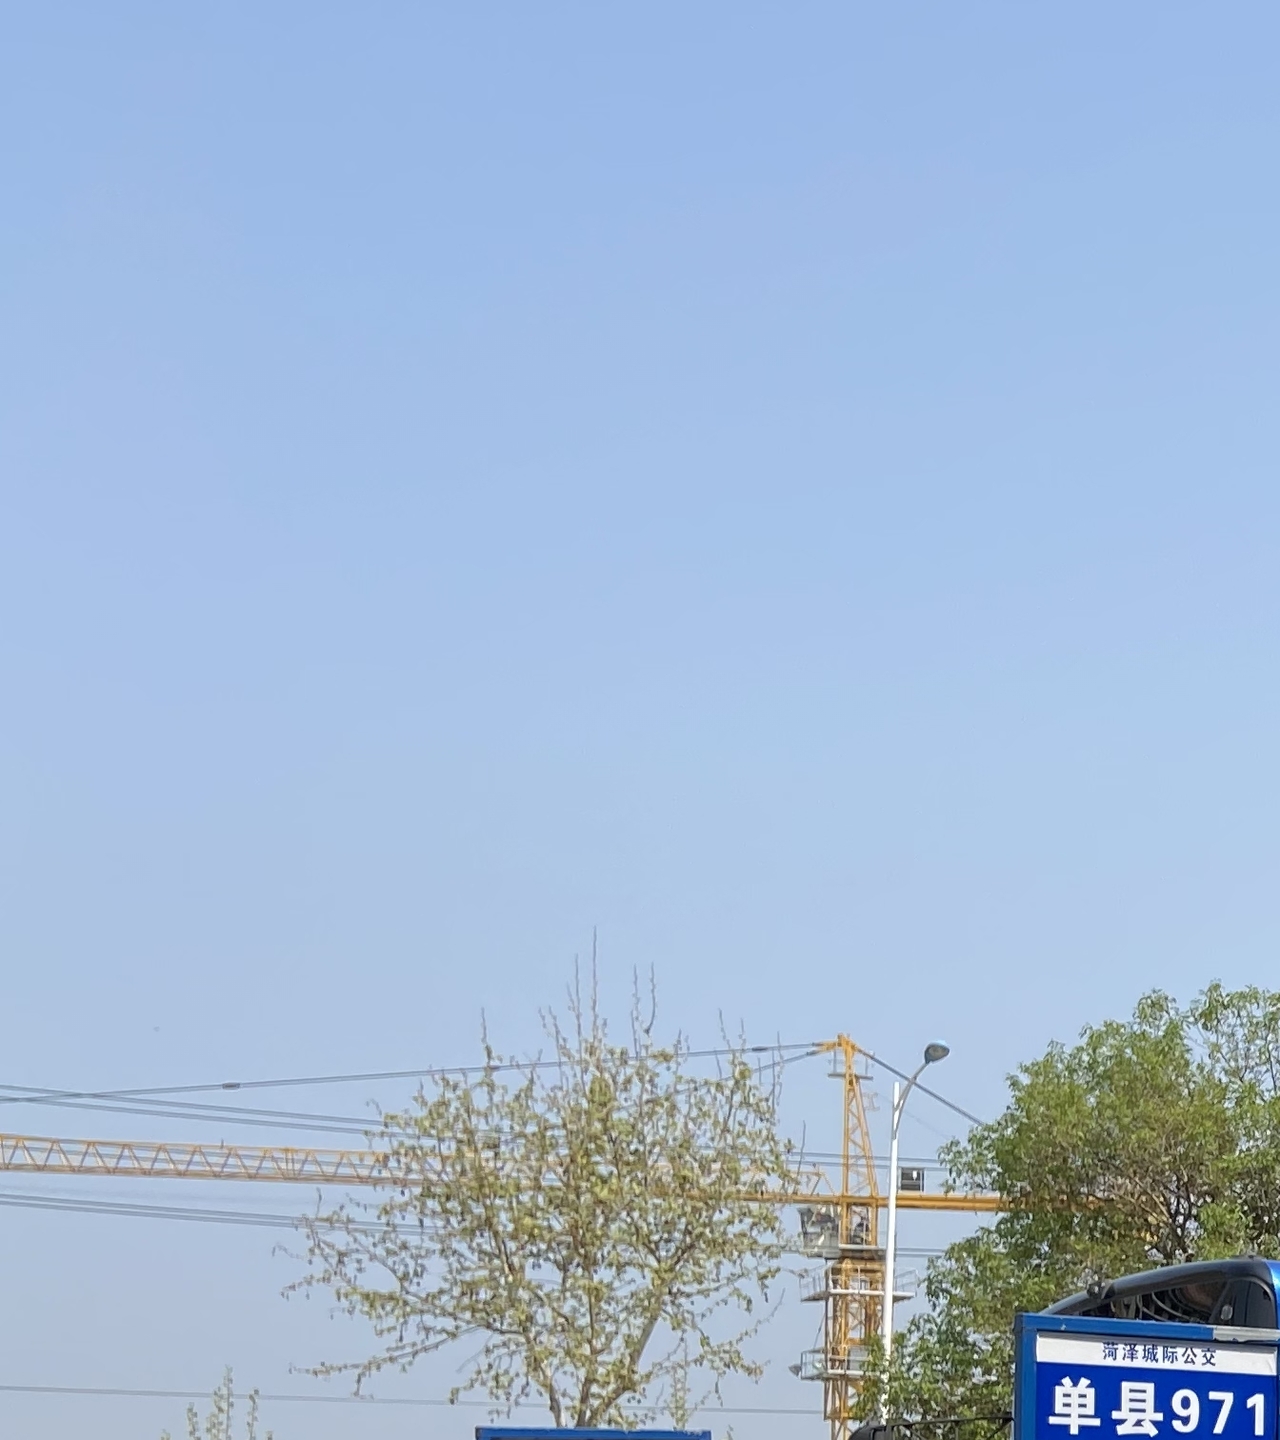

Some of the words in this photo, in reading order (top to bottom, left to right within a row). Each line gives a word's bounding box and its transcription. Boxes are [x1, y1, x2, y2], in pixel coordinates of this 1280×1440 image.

[1102, 1341, 1217, 1367] 菏泽城际公交
[1047, 1375, 1266, 1438] 单县971
